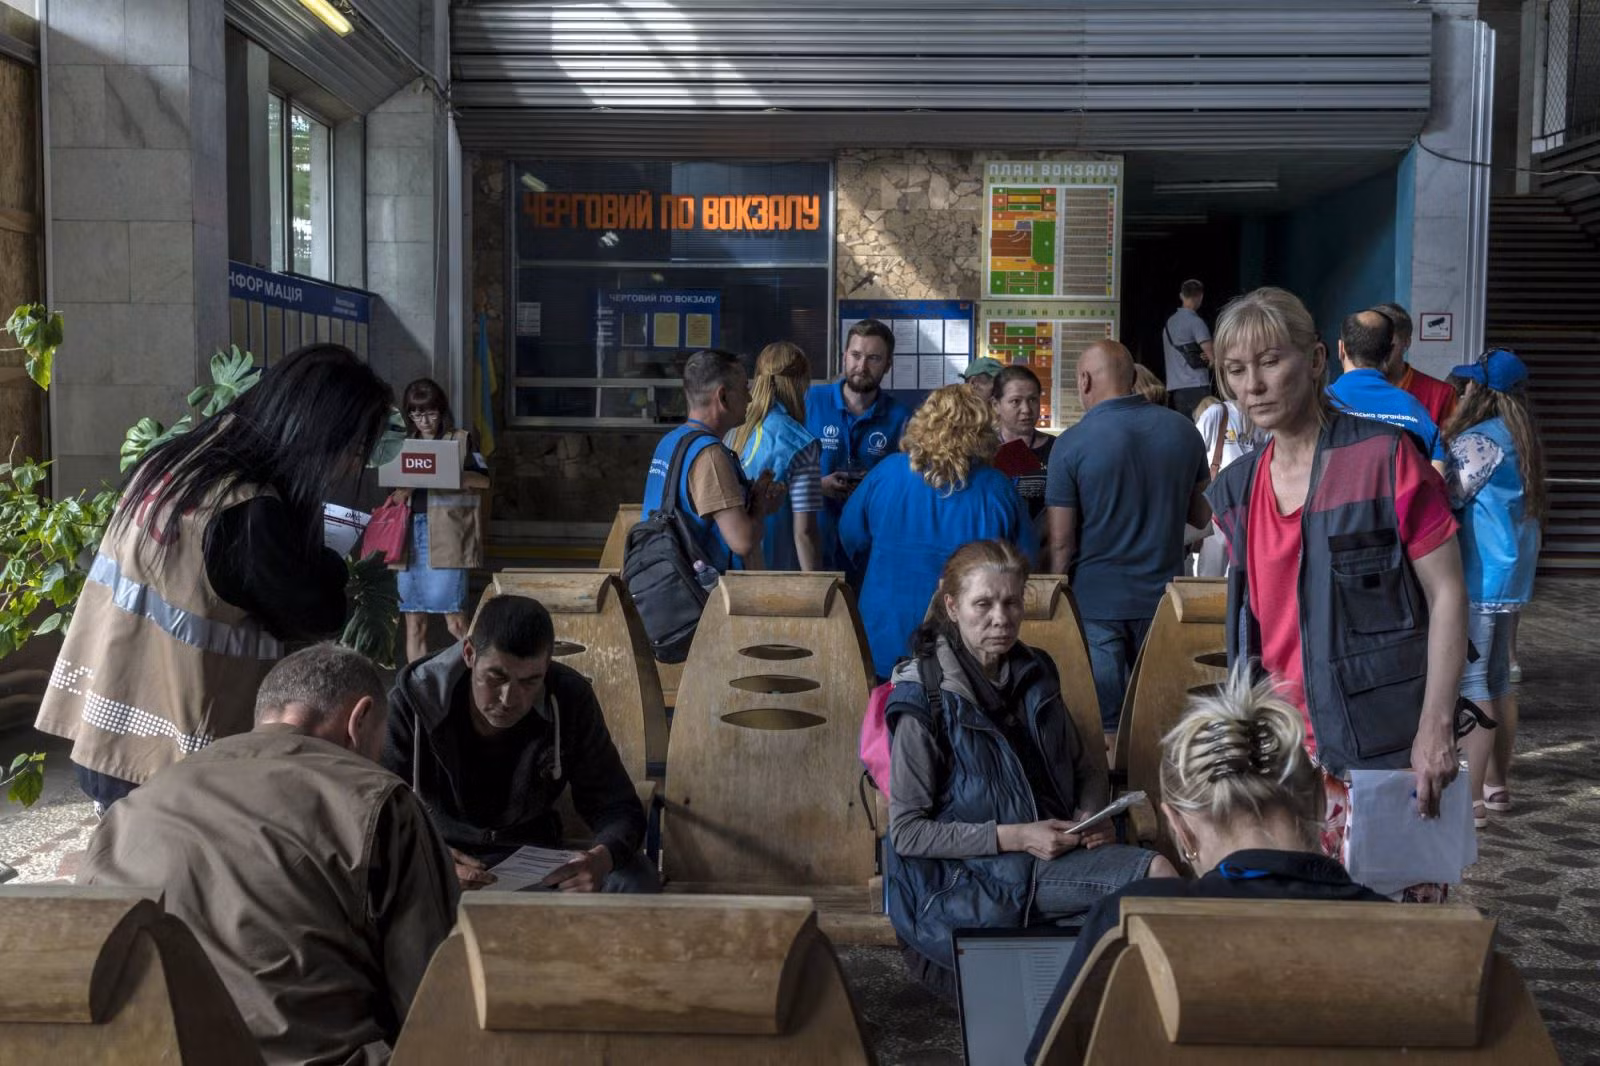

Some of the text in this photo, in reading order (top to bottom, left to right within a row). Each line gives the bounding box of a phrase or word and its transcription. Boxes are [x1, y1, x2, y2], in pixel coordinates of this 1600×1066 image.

[989, 164, 1119, 176] ПЛАН ВОКЗАЛУ
[522, 190, 820, 230] ЧЕРГОВИЙ ПО ВОКЗАЛУ
[228, 271, 303, 303] НФОРМАЦІЯ
[608, 293, 718, 304] ЧЕРГОВИЙ ПО ВОКЗАЛУ
[405, 458, 433, 469] DRC
